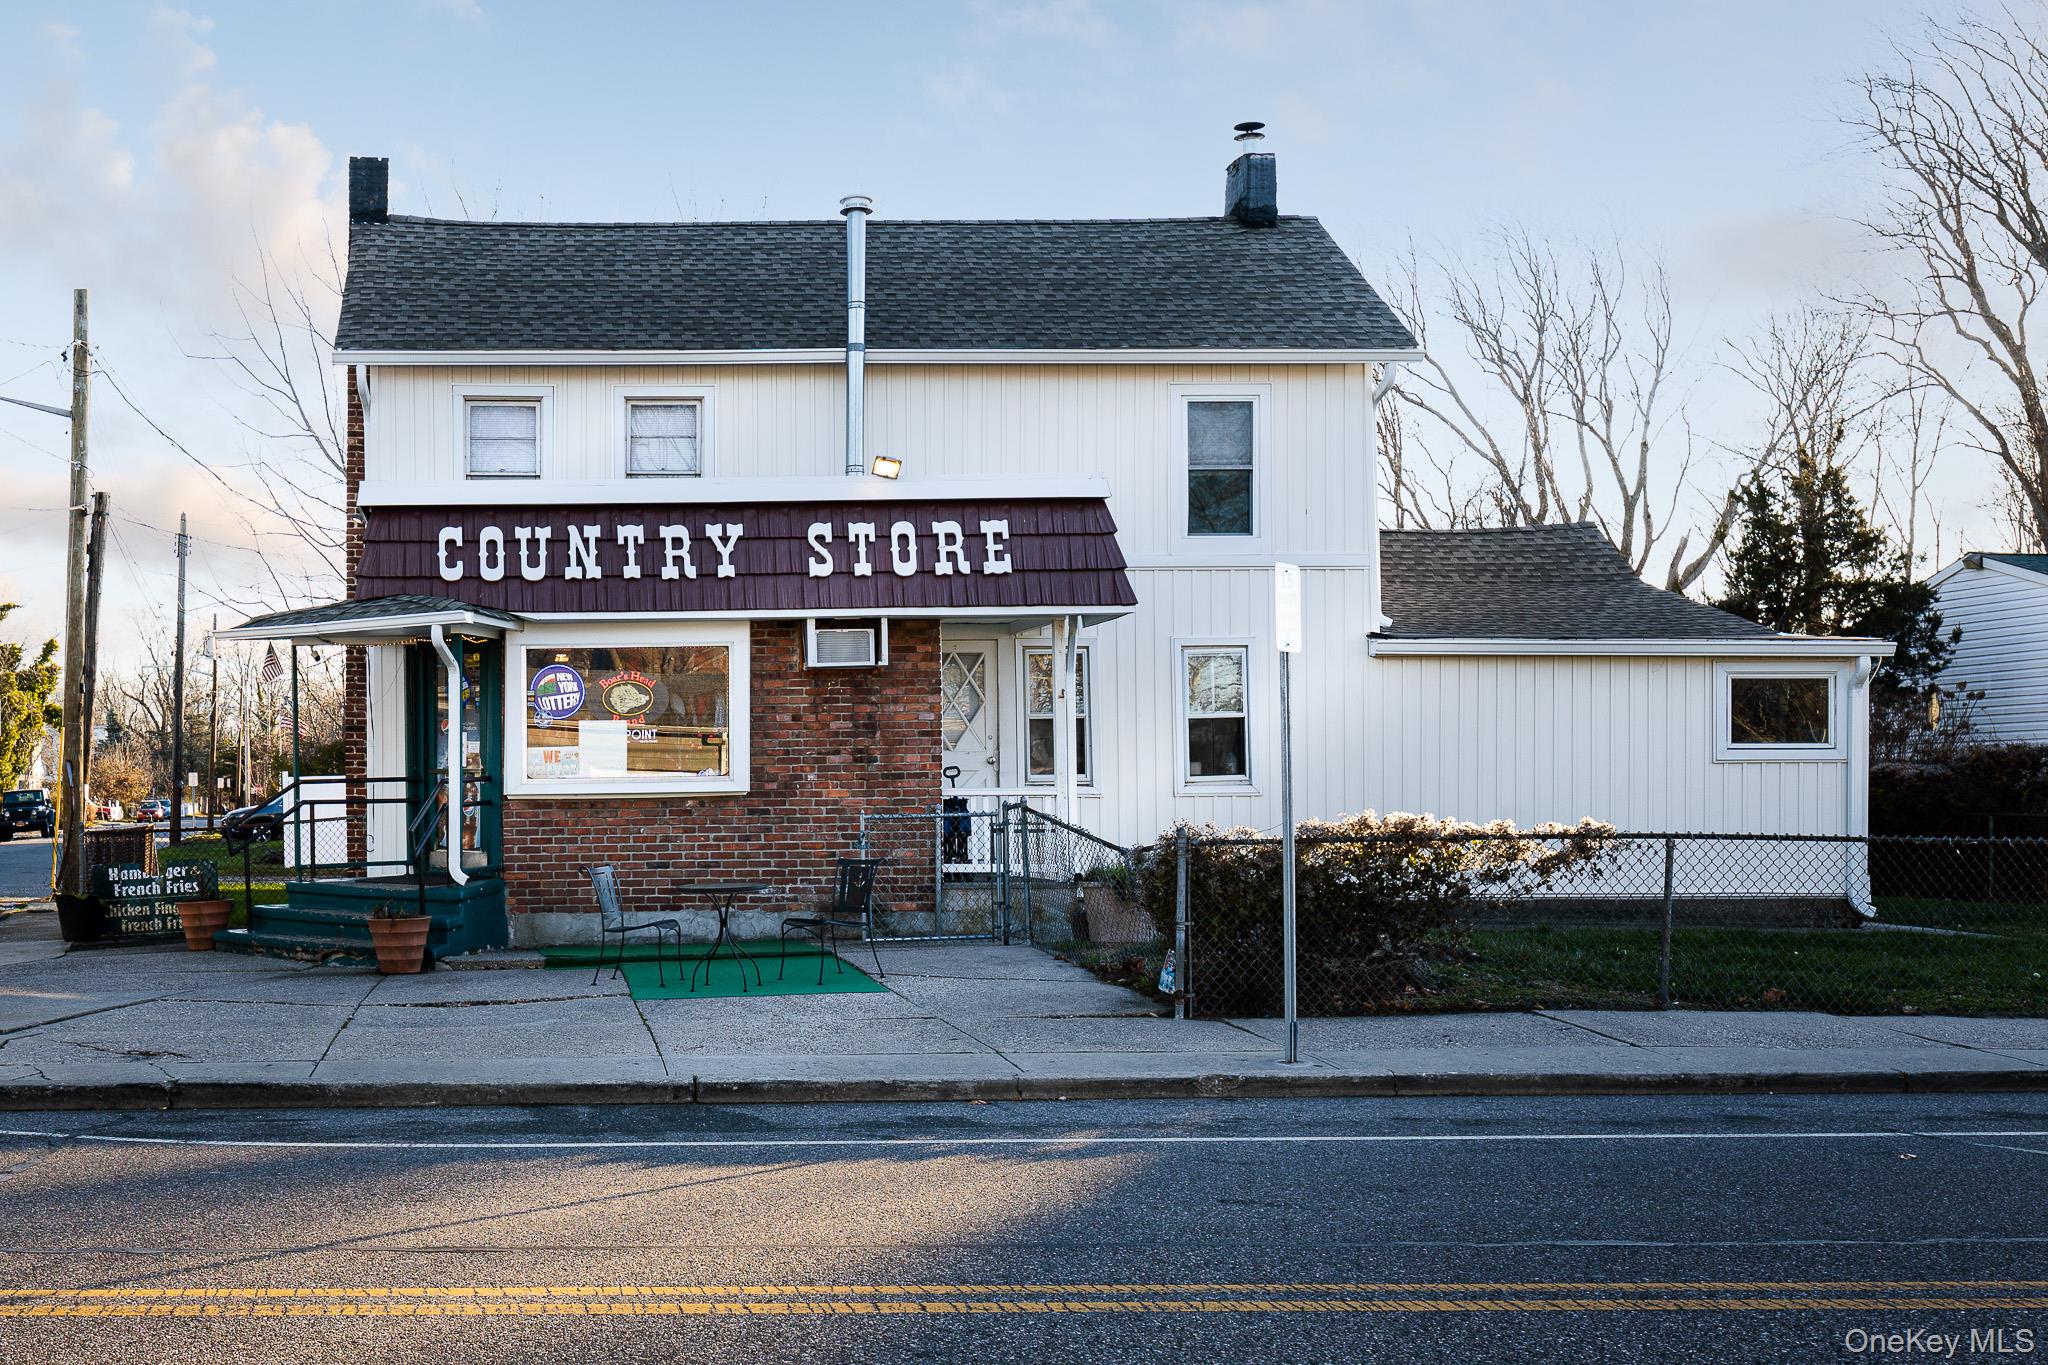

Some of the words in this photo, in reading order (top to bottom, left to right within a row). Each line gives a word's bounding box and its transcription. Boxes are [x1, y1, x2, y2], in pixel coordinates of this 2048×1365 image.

[437, 523, 744, 581] COUNTRY
[807, 519, 1013, 578] STORE
[556, 672, 573, 682] NEW
[599, 671, 629, 690] Boar's
[630, 671, 657, 688] Head
[558, 681, 579, 693] YORK
[537, 692, 580, 711] LOTTERY
[612, 713, 646, 726] Band
[543, 750, 561, 764] WE
[108, 866, 188, 880] Hamger
[114, 882, 160, 896] French
[166, 880, 199, 893] Fries
[121, 918, 162, 932] French
